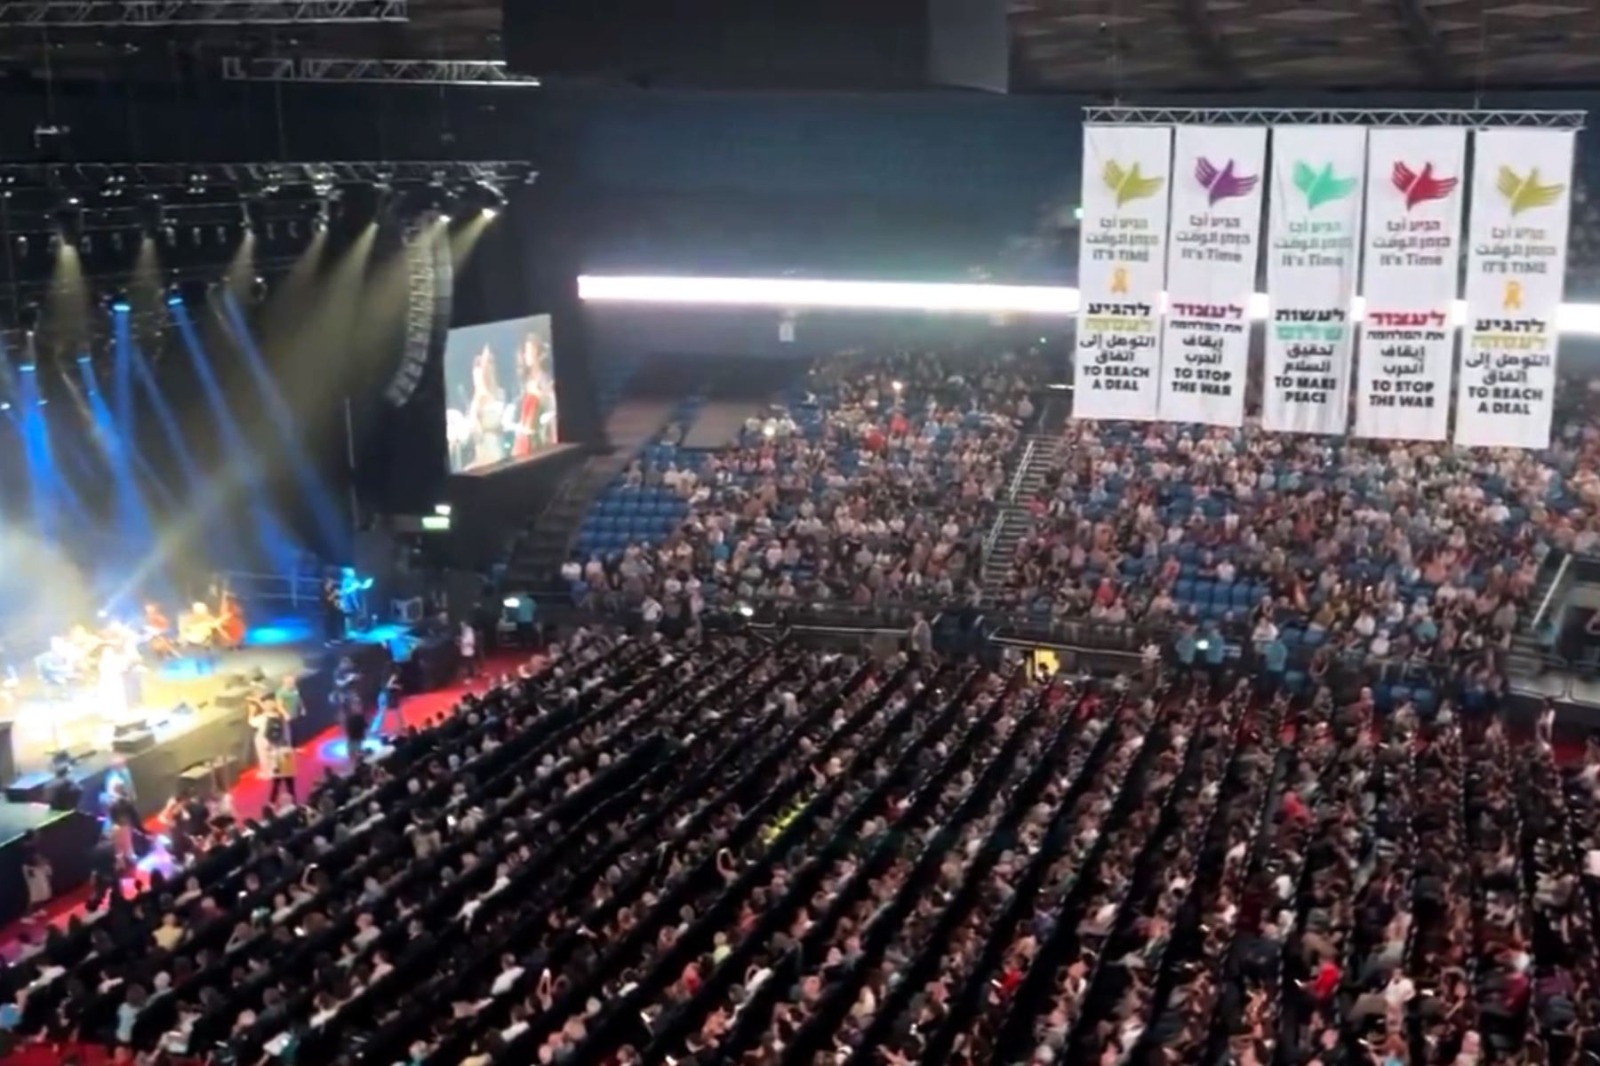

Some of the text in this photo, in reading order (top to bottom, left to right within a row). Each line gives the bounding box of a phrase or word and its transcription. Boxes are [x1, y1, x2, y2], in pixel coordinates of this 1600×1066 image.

[1093, 248, 1148, 262] IT'S TIME
[1181, 248, 1242, 262] It's Time
[1281, 254, 1344, 267] It's Time
[1380, 253, 1442, 266] It's Time
[1482, 261, 1546, 274] IT'S TIME
[1087, 302, 1151, 316] להגיע
[1172, 303, 1243, 319] לעצור
[1275, 308, 1344, 322] לעשות
[1368, 310, 1446, 327] לעצור
[1475, 318, 1545, 332] להגיע
[1185, 353, 1222, 366] الحرب
[1083, 365, 1150, 378] TO REACH
[1174, 367, 1231, 381] TO STOP
[1383, 363, 1424, 377] الحرب
[1092, 379, 1139, 391] A DEAL
[1171, 381, 1231, 396] THE WAR
[1274, 376, 1336, 390] TO MAKE
[1371, 379, 1434, 393] TO STOP
[1285, 391, 1327, 404] PEACE
[1468, 386, 1543, 400] TO REACH
[1369, 394, 1434, 407] THE WAR
[1478, 401, 1531, 415] A DEAL
